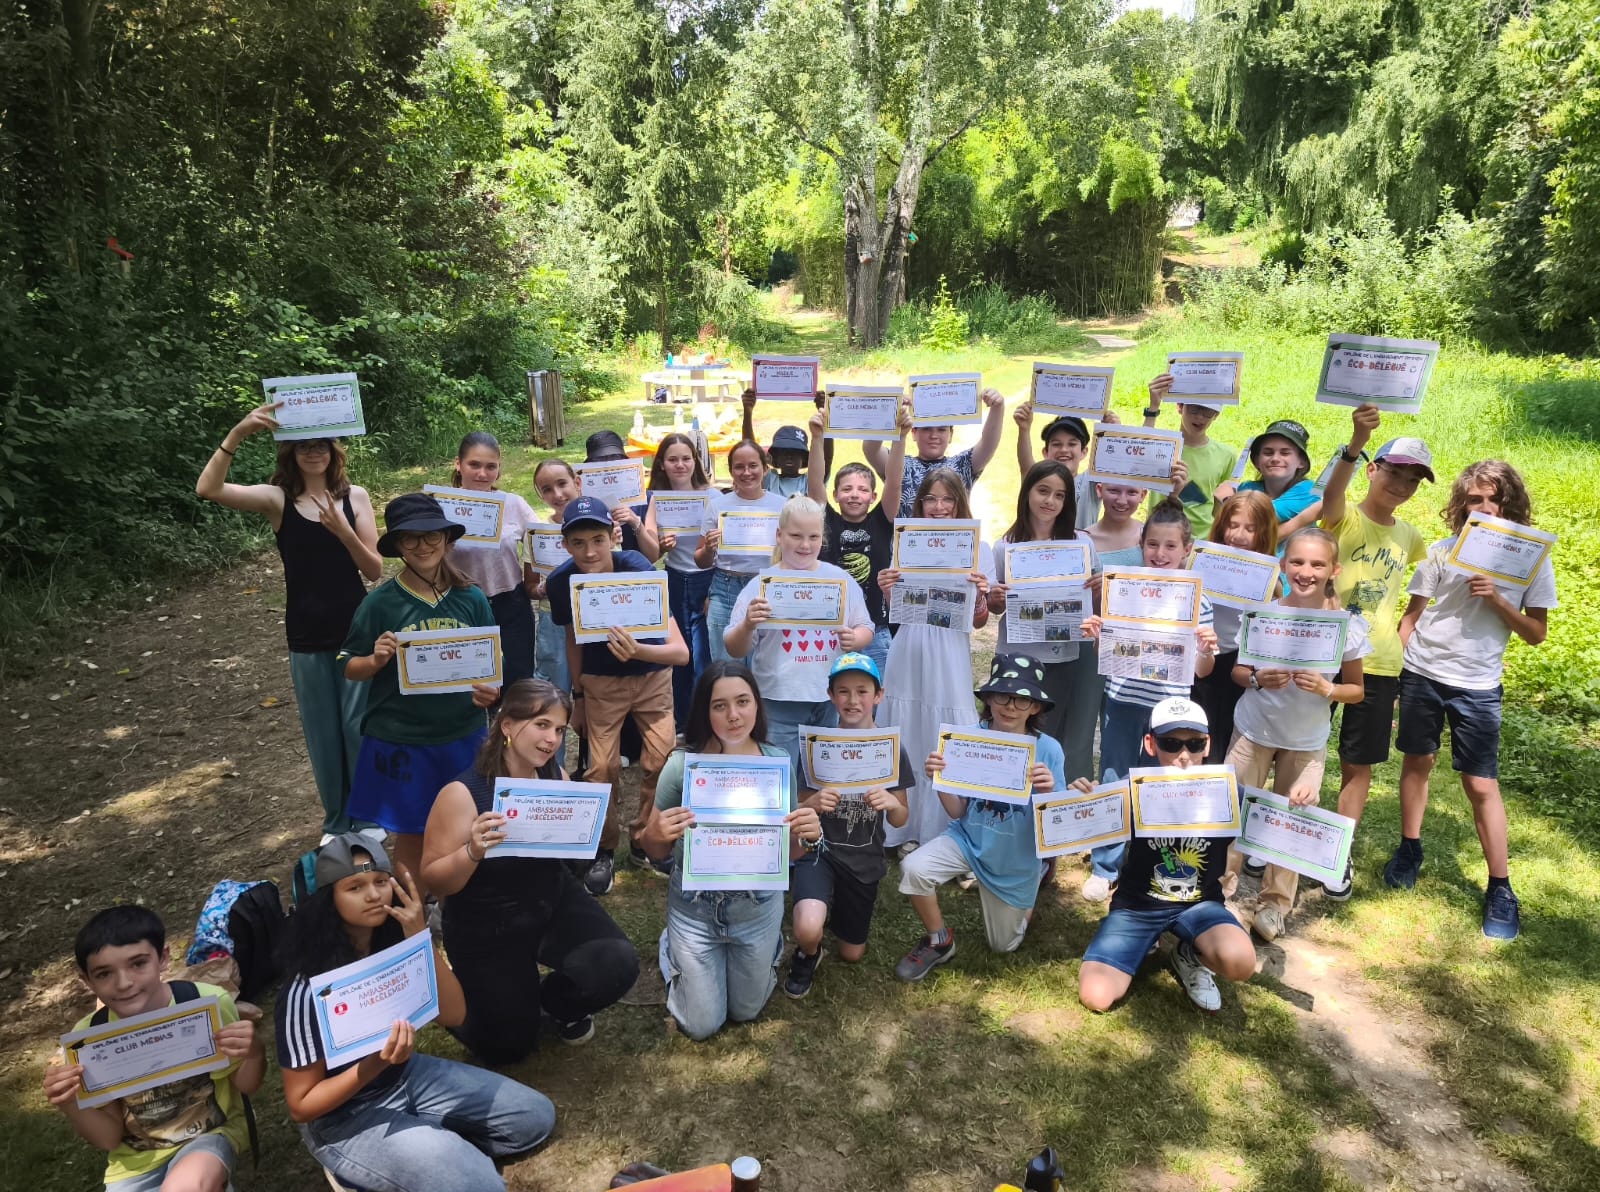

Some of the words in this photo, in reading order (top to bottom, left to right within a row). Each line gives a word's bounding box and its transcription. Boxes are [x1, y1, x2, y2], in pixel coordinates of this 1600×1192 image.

[1126, 445, 1146, 456] CVC
[603, 476, 618, 485] CVC
[455, 506, 473, 517] CVC
[928, 537, 946, 548] CVC
[611, 592, 633, 605] CVC
[793, 590, 813, 600] CVC
[1141, 587, 1162, 599] CVC
[440, 649, 463, 661] CVC
[841, 749, 863, 760] CVC
[1074, 808, 1095, 820] CVC
[358, 972, 408, 1001] AMBASSADEUR
[115, 1043, 138, 1054] CLUB
[140, 1031, 174, 1048] MÉDIAS
